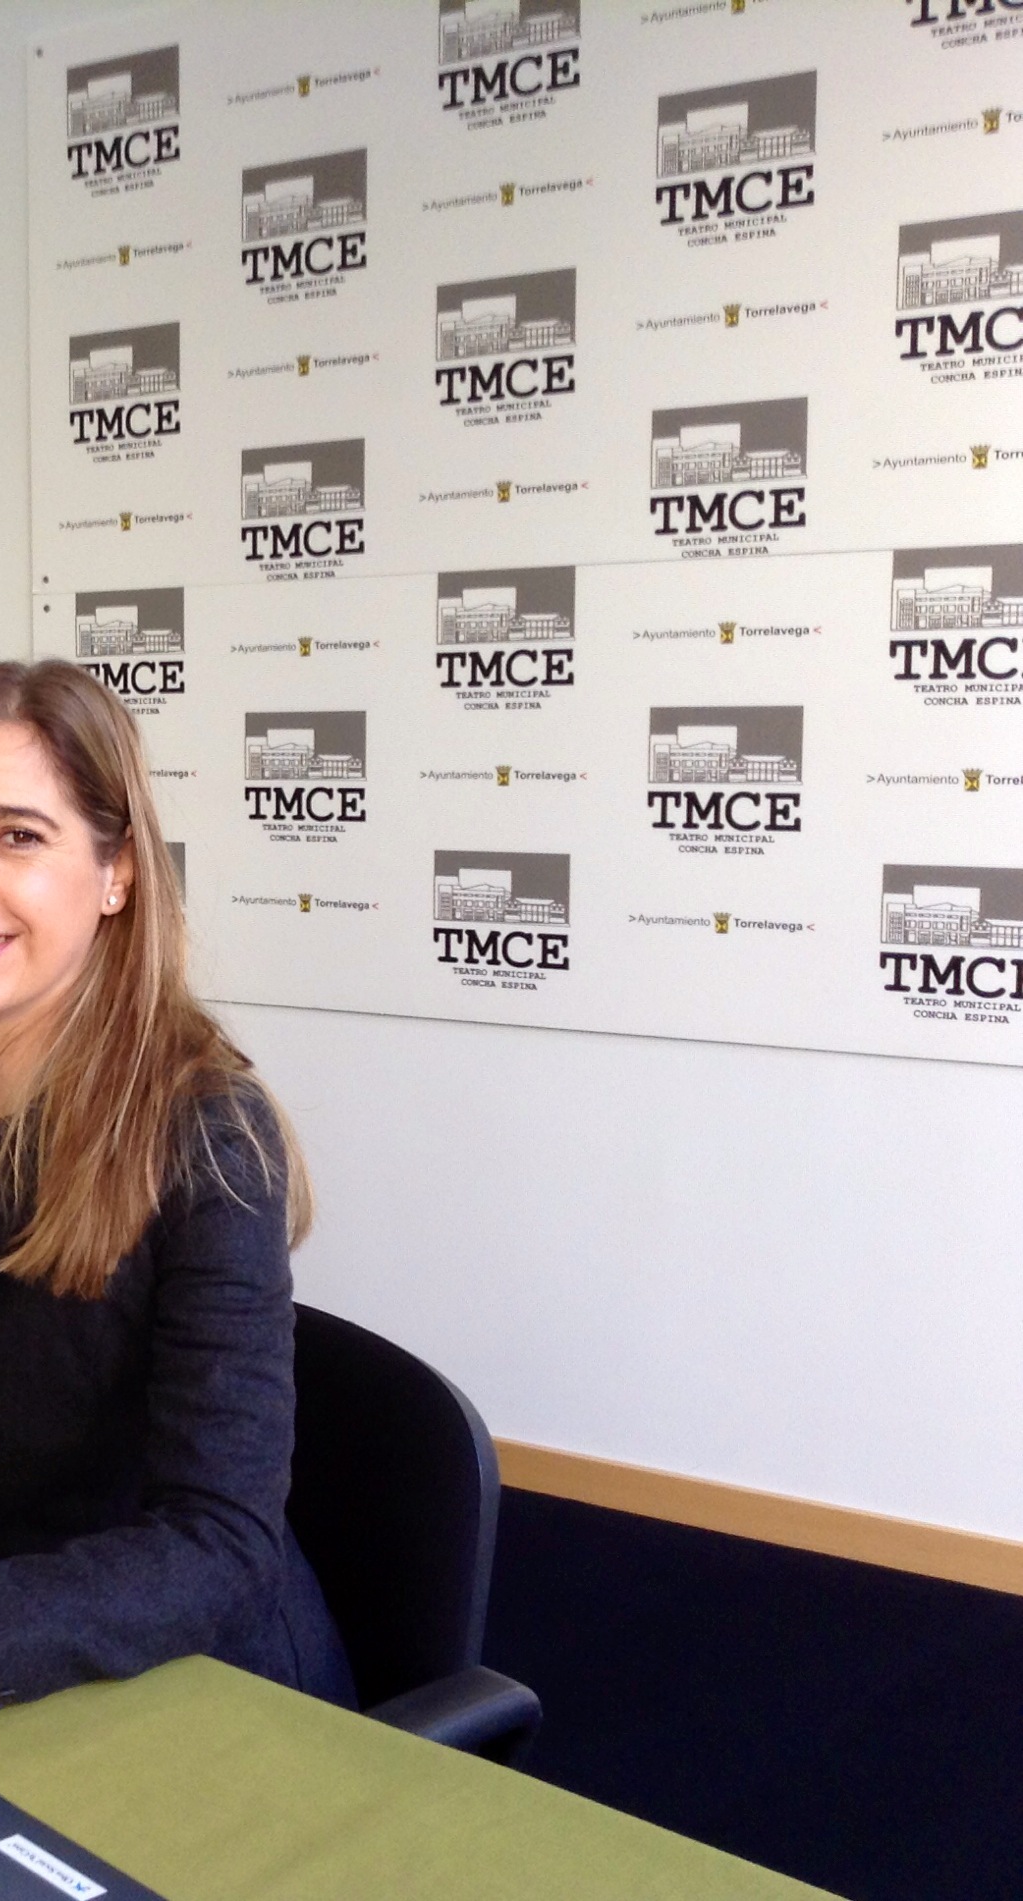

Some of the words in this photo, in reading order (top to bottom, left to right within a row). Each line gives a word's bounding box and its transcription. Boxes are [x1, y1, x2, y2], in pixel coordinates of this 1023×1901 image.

[314, 69, 371, 87] Torrelavega
[438, 48, 580, 109] TMCE
[67, 125, 180, 178] TMCE
[518, 179, 583, 196] Torrelavega
[655, 165, 814, 225] TMCE
[677, 223, 718, 236] TEATRO
[724, 214, 787, 229] MUNICIPAL
[687, 234, 727, 247] CONCHA
[734, 228, 776, 241] ESPINA
[133, 242, 184, 258] Torrelavega
[241, 232, 366, 284] TMCE
[745, 302, 816, 318] Torrelavega
[313, 354, 370, 368] Torrelavega
[919, 360, 965, 371] TEATRO
[435, 355, 575, 405] TMCE
[930, 372, 975, 384] CONCHA
[69, 400, 180, 443] TMCE
[514, 483, 578, 495] Torrelavega
[650, 487, 805, 535] TMCE
[134, 514, 184, 524] Torrelavega
[241, 518, 364, 560] TMCE
[671, 537, 712, 547] TEATRO
[717, 533, 779, 544] MUNICIPAL
[681, 548, 722, 559] CONCHA
[727, 546, 768, 556] ESPINA
[259, 562, 291, 571] TEATRO
[294, 559, 343, 569] MUNICIPAL
[266, 572, 298, 582] CONCHA
[303, 570, 335, 579] ESPINA
[739, 626, 810, 638] Torrelavega
[314, 640, 371, 651] Torrelavega
[889, 637, 1023, 680] TMC
[436, 648, 574, 688] TMCE
[455, 691, 491, 699] TEATRO
[496, 690, 550, 698] MUNICIPAL
[913, 684, 958, 693] TEATRO
[463, 702, 499, 710] CONCHA
[505, 701, 541, 710] ESPINA
[923, 697, 968, 706] CONCHA
[976, 696, 1021, 705] ESPINA
[149, 769, 189, 779] rrelavega
[513, 770, 576, 782] Torrelavega
[244, 786, 366, 822] TMCE
[647, 791, 801, 831] TMCE
[262, 823, 293, 831] TEATRO
[297, 824, 346, 833] MUNICIPAL
[269, 834, 301, 842] CONCHA
[305, 835, 337, 843] ESPINA
[669, 832, 708, 842] TEATRO
[714, 834, 774, 843] MUNICIPAL
[678, 844, 718, 853] CONCHA
[724, 846, 764, 855] ESPINA
[314, 898, 370, 912] Torrelavega
[734, 918, 803, 933] Torrelavega
[433, 927, 569, 970] TMCE
[452, 966, 488, 976] TEATRO
[492, 969, 546, 980] MUNICIPAL
[461, 978, 496, 987] CONCHA
[501, 981, 537, 990] ESPINA
[903, 997, 947, 1007] TEATRO
[953, 1000, 1021, 1012] MUNICIPAL
[913, 1010, 957, 1020] CONCHA
[964, 1013, 1009, 1024] ESPINA
